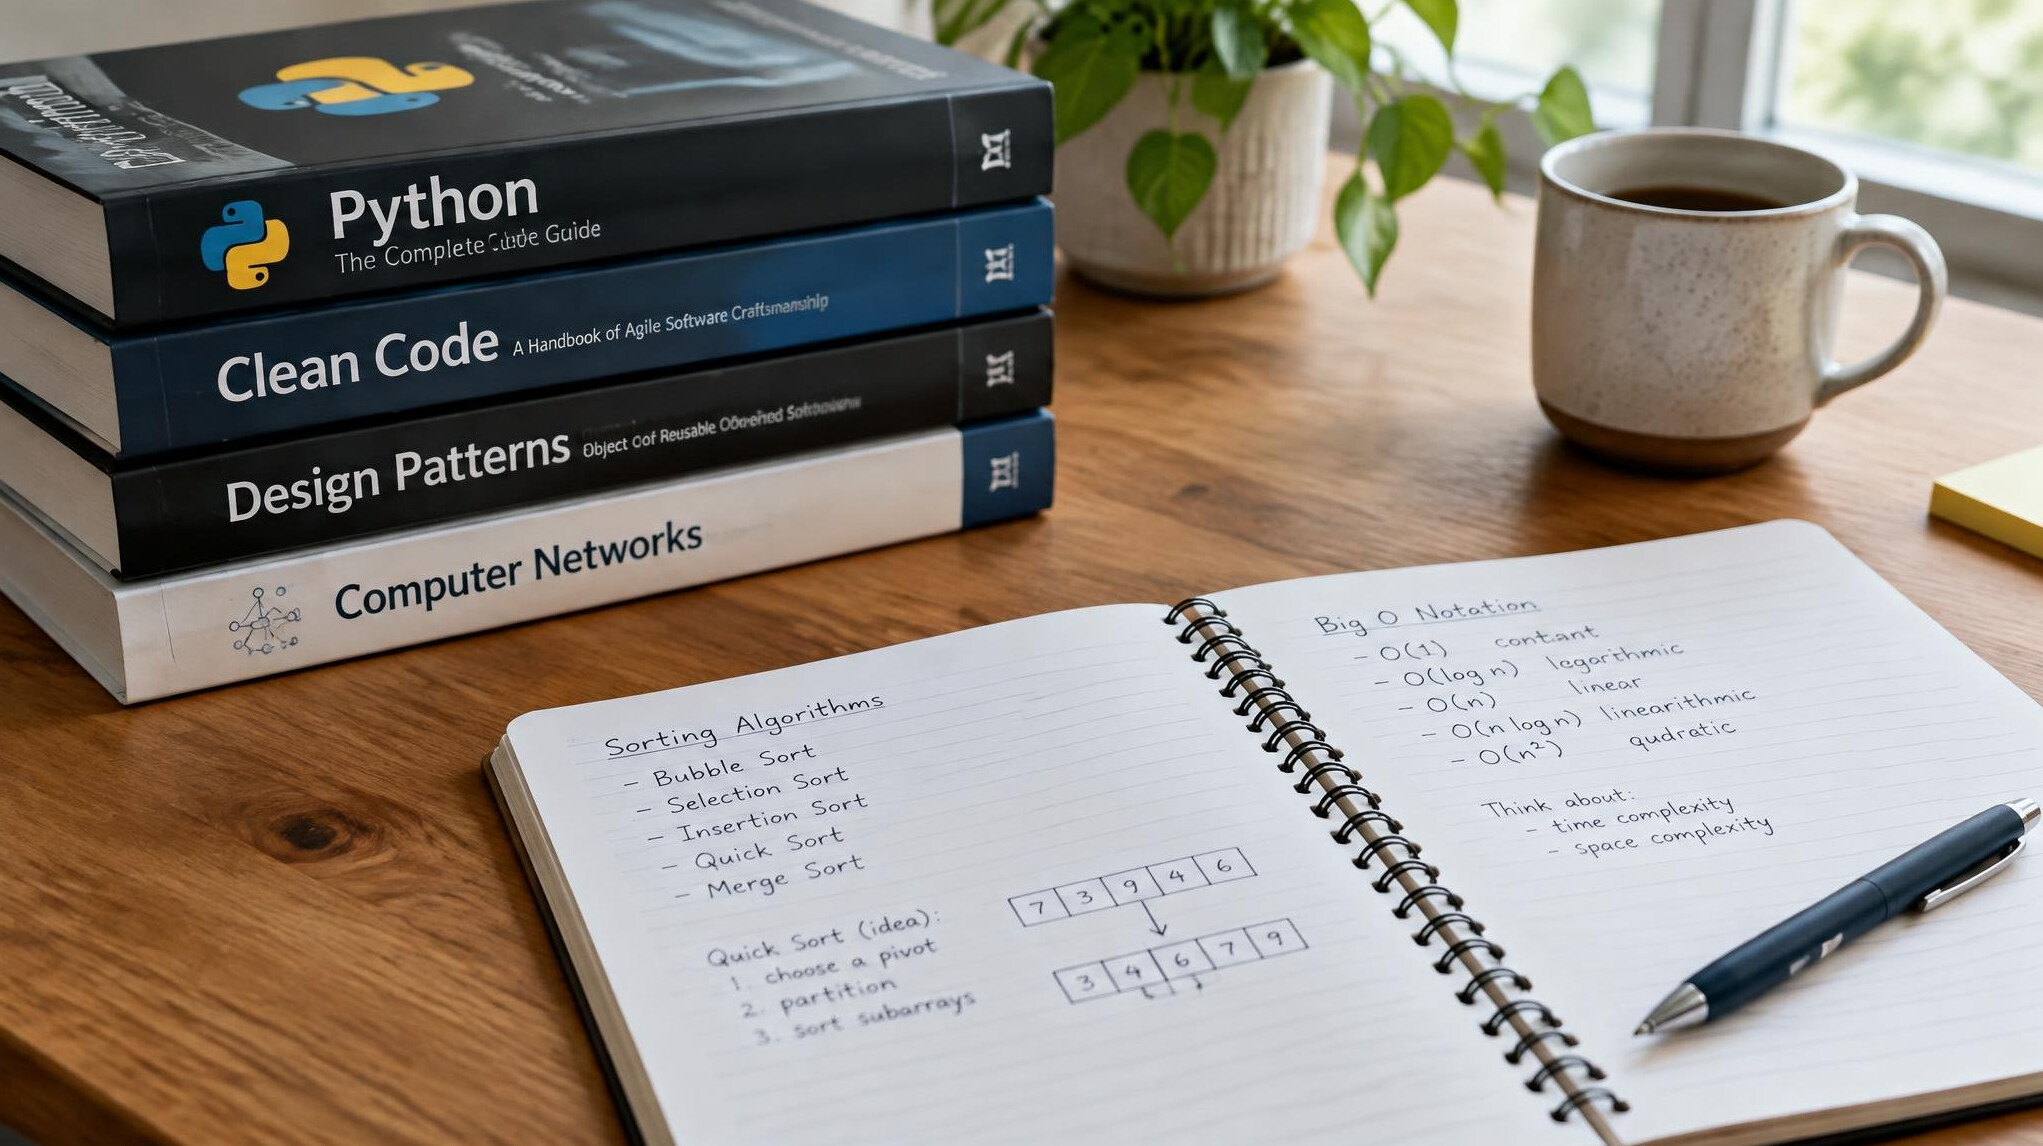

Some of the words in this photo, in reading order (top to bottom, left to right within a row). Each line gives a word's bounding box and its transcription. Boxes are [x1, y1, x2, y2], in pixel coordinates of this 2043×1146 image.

[330, 174, 539, 247] Python
[335, 252, 377, 274] The
[384, 239, 485, 266] Complete
[545, 219, 602, 244] Guide
[217, 352, 360, 402] Clean
[375, 321, 499, 377] Code
[513, 340, 524, 357] A
[528, 327, 602, 355] Handbook
[605, 324, 621, 341] of
[625, 316, 662, 340] Agile
[665, 309, 728, 332] Software
[227, 466, 380, 523] Design
[394, 434, 572, 490] Patterns
[660, 421, 717, 444] Reusable
[335, 560, 524, 620] Computer
[533, 520, 703, 580] Networks
[1314, 615, 1369, 637] Big
[1378, 610, 1398, 625] O
[1415, 599, 1538, 622] Notation
[1380, 640, 1448, 661] O(1)
[1427, 691, 1496, 713] O(n)
[1568, 676, 1642, 696] linear
[1451, 719, 1506, 739] O(n
[1599, 688, 1756, 721] linearithmic
[605, 728, 718, 756] Sorting
[736, 695, 885, 736] Algorithms
[653, 759, 744, 787] Bubble
[759, 744, 816, 766] Sort
[667, 785, 781, 814] Selection
[792, 766, 849, 790] Sort
[1480, 798, 1552, 818] Think
[1565, 787, 1636, 808] about:
[676, 811, 798, 842] Insertion
[811, 793, 868, 816] Sort
[1551, 817, 1606, 834] time
[1616, 797, 1735, 823] complexity
[1574, 836, 1638, 859] space
[1650, 816, 1774, 846] complexity
[695, 842, 773, 871] Quick
[787, 826, 844, 851] Sort
[708, 873, 789, 898] Merge
[805, 854, 865, 879] Sort
[1028, 900, 1044, 915] 7
[1076, 890, 1093, 905] 3
[1123, 879, 1139, 894] 9
[1169, 869, 1185, 883] 4
[1216, 858, 1232, 873] 6
[707, 940, 781, 967] Quick
[791, 928, 844, 952] Sort
[858, 908, 941, 940] (idea):
[765, 960, 839, 985] choose
[851, 955, 867, 968] a
[879, 938, 938, 969] pivot
[1079, 975, 1095, 992] 3
[1125, 965, 1142, 980] 4
[1175, 952, 1189, 968] 6
[1219, 941, 1234, 956] 7
[1267, 931, 1283, 947] 9
[780, 977, 898, 1015] partition
[795, 1016, 845, 1040] sort
[858, 991, 977, 1026] subarrays
